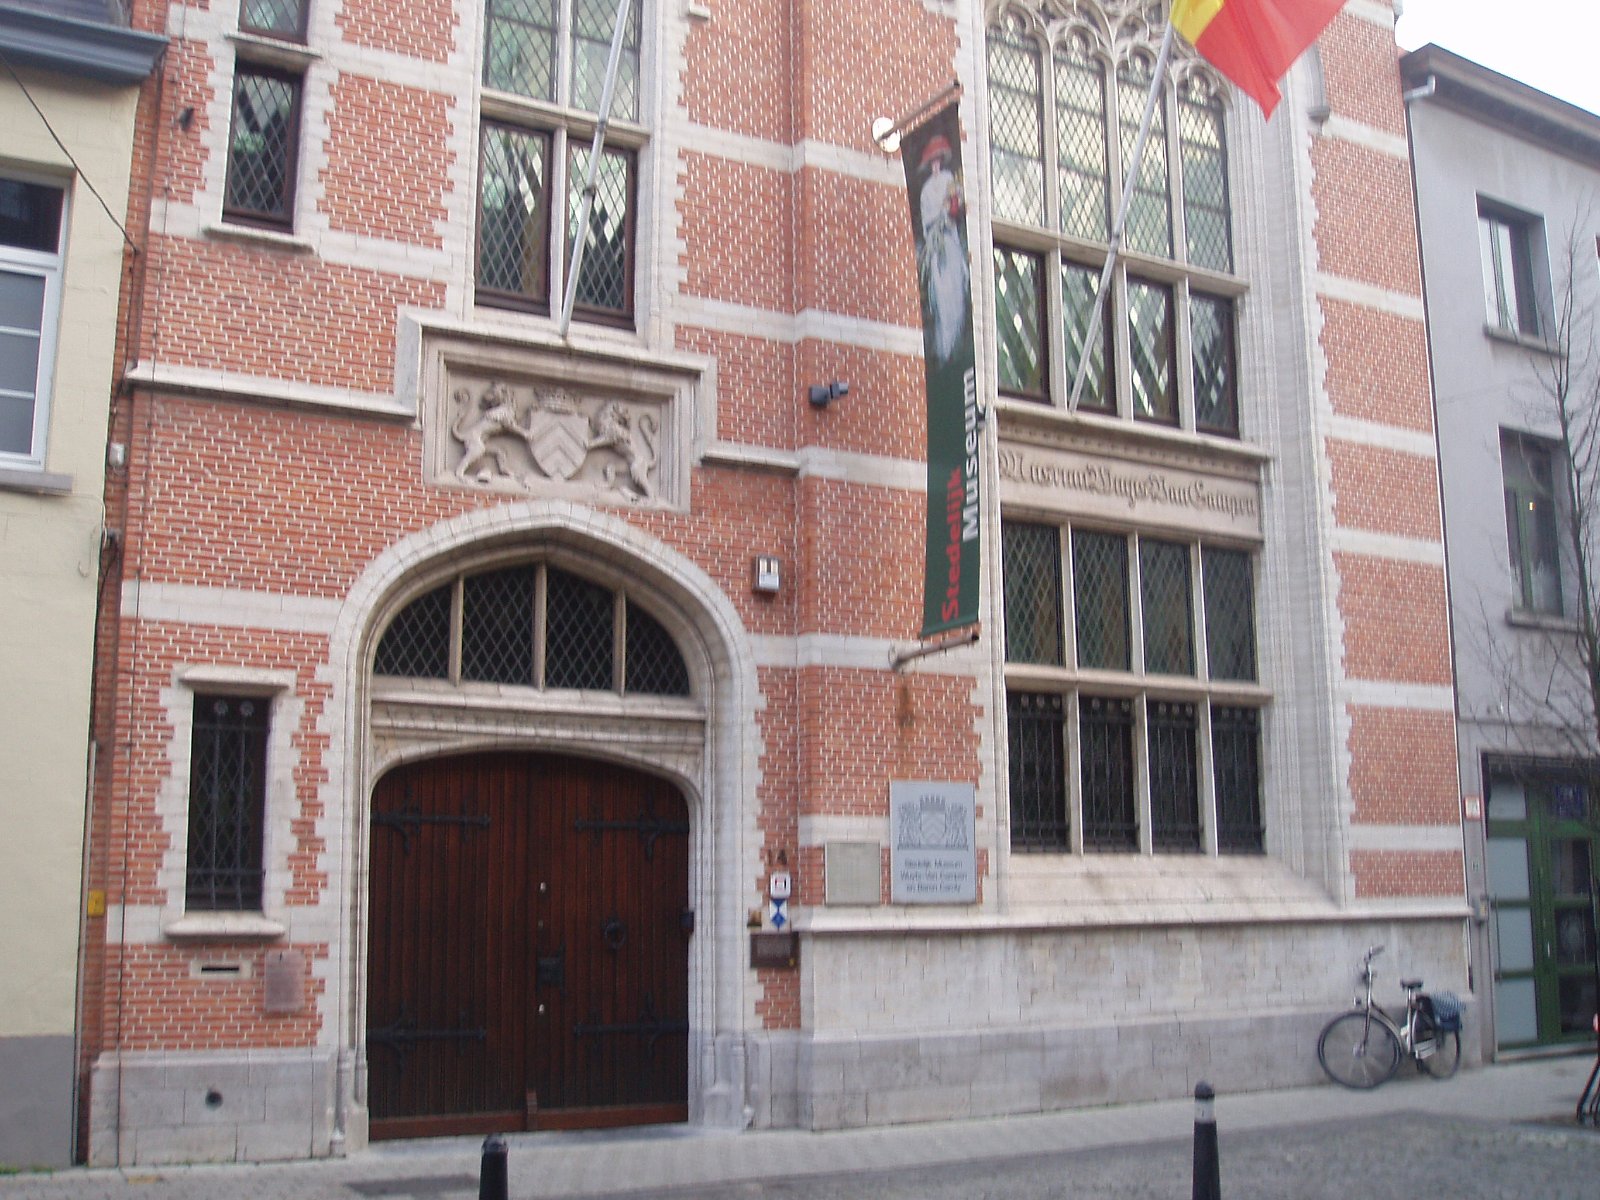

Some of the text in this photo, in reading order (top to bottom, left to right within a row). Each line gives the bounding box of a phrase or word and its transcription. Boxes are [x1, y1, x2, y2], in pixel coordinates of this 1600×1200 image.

[962, 366, 979, 542] Museum
[999, 450, 1088, 489] Museum
[941, 465, 964, 624] Stedelijk
